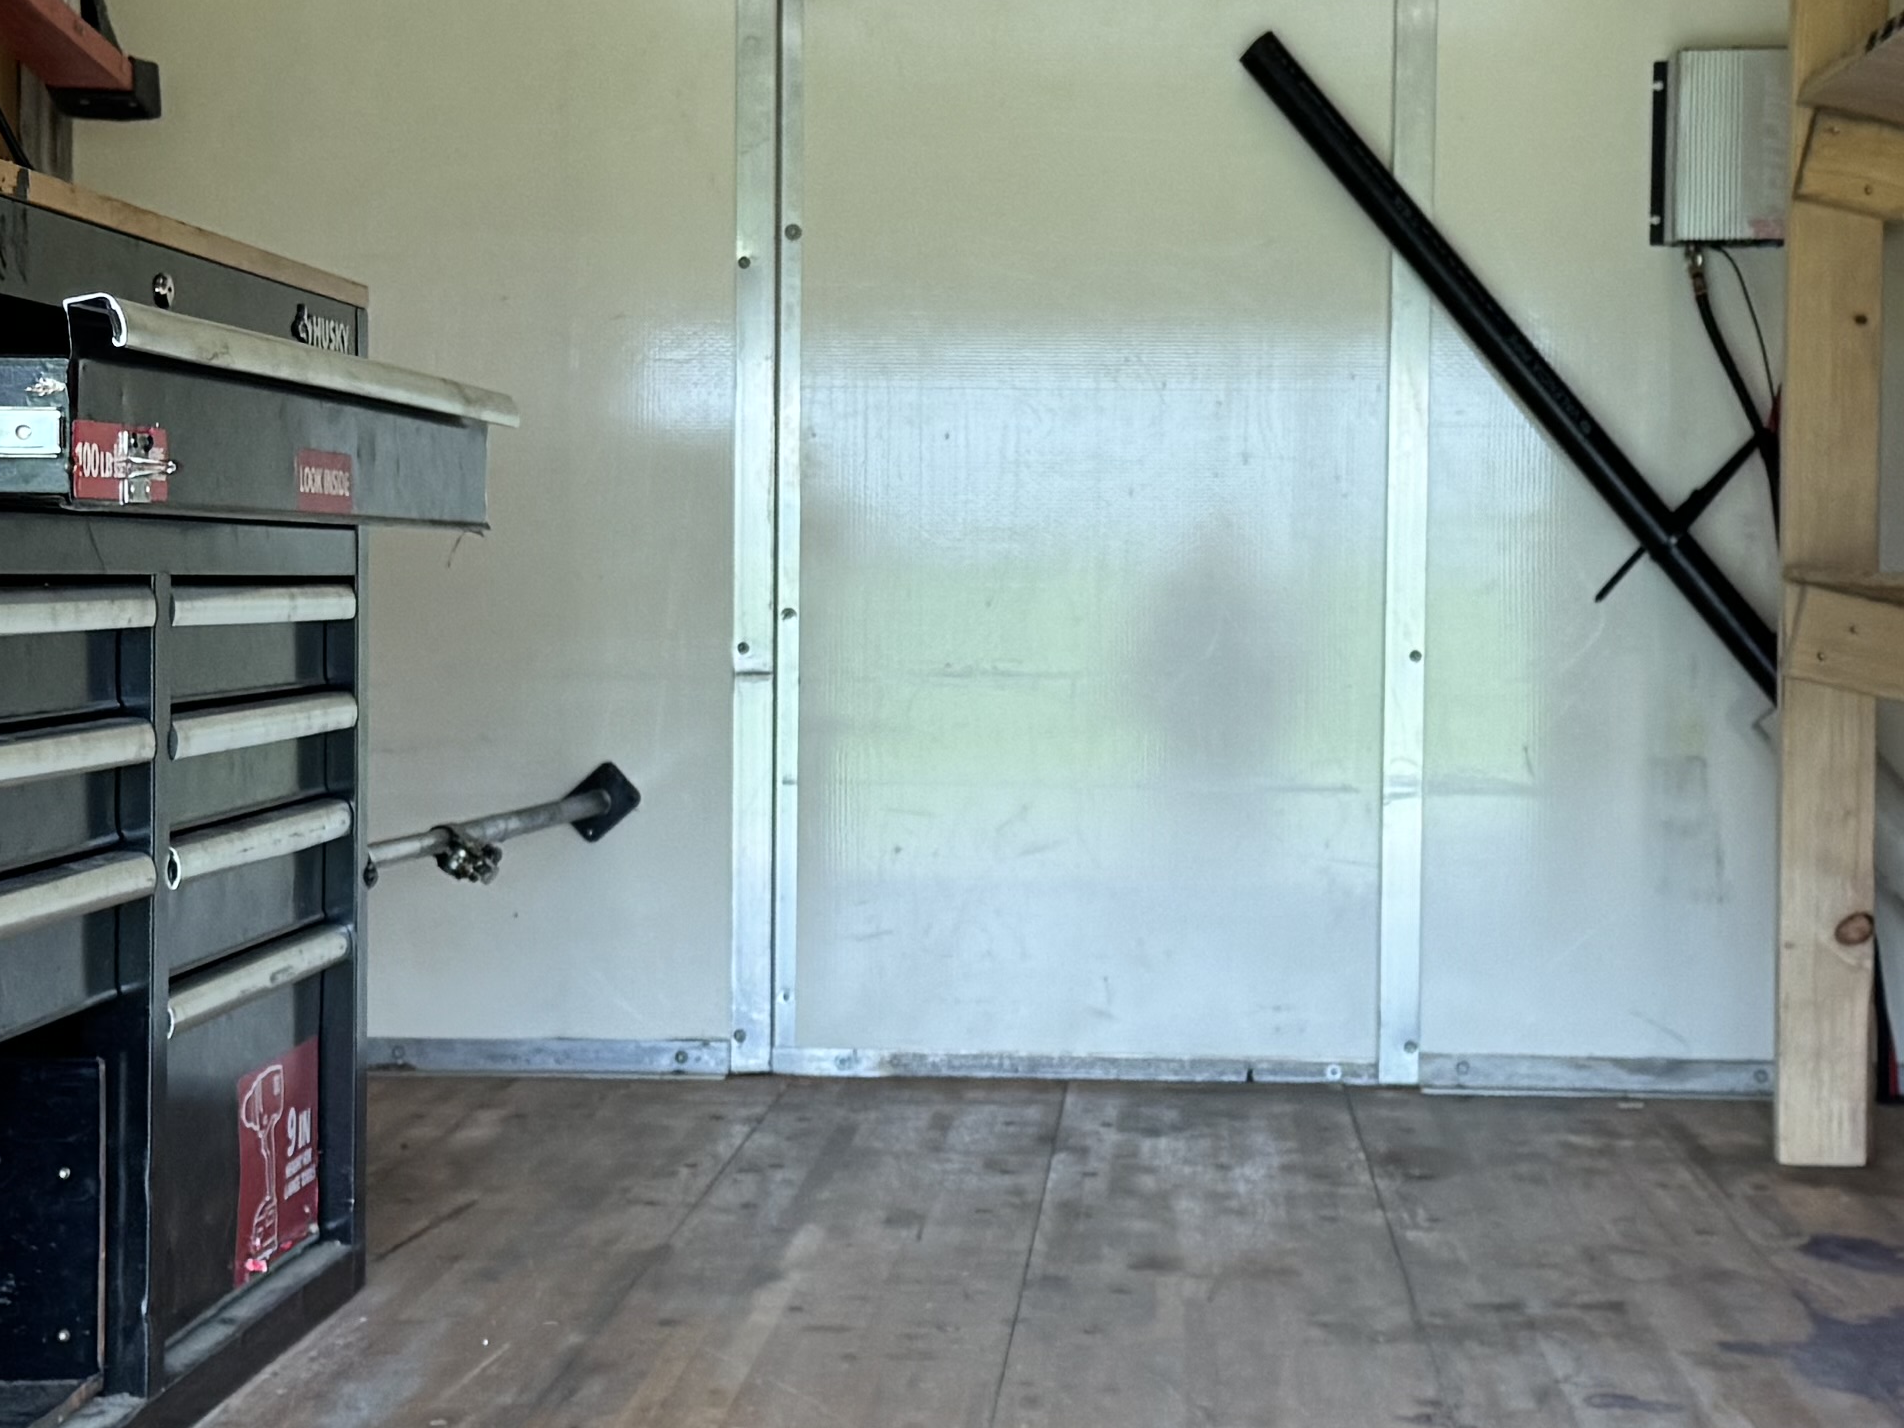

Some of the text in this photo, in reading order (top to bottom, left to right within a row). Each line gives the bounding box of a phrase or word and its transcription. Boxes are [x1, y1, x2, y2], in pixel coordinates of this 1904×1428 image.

[312, 315, 350, 355] HUSKY
[299, 465, 350, 497] LOOK INSIDE
[287, 1106, 312, 1158] 9 IN
